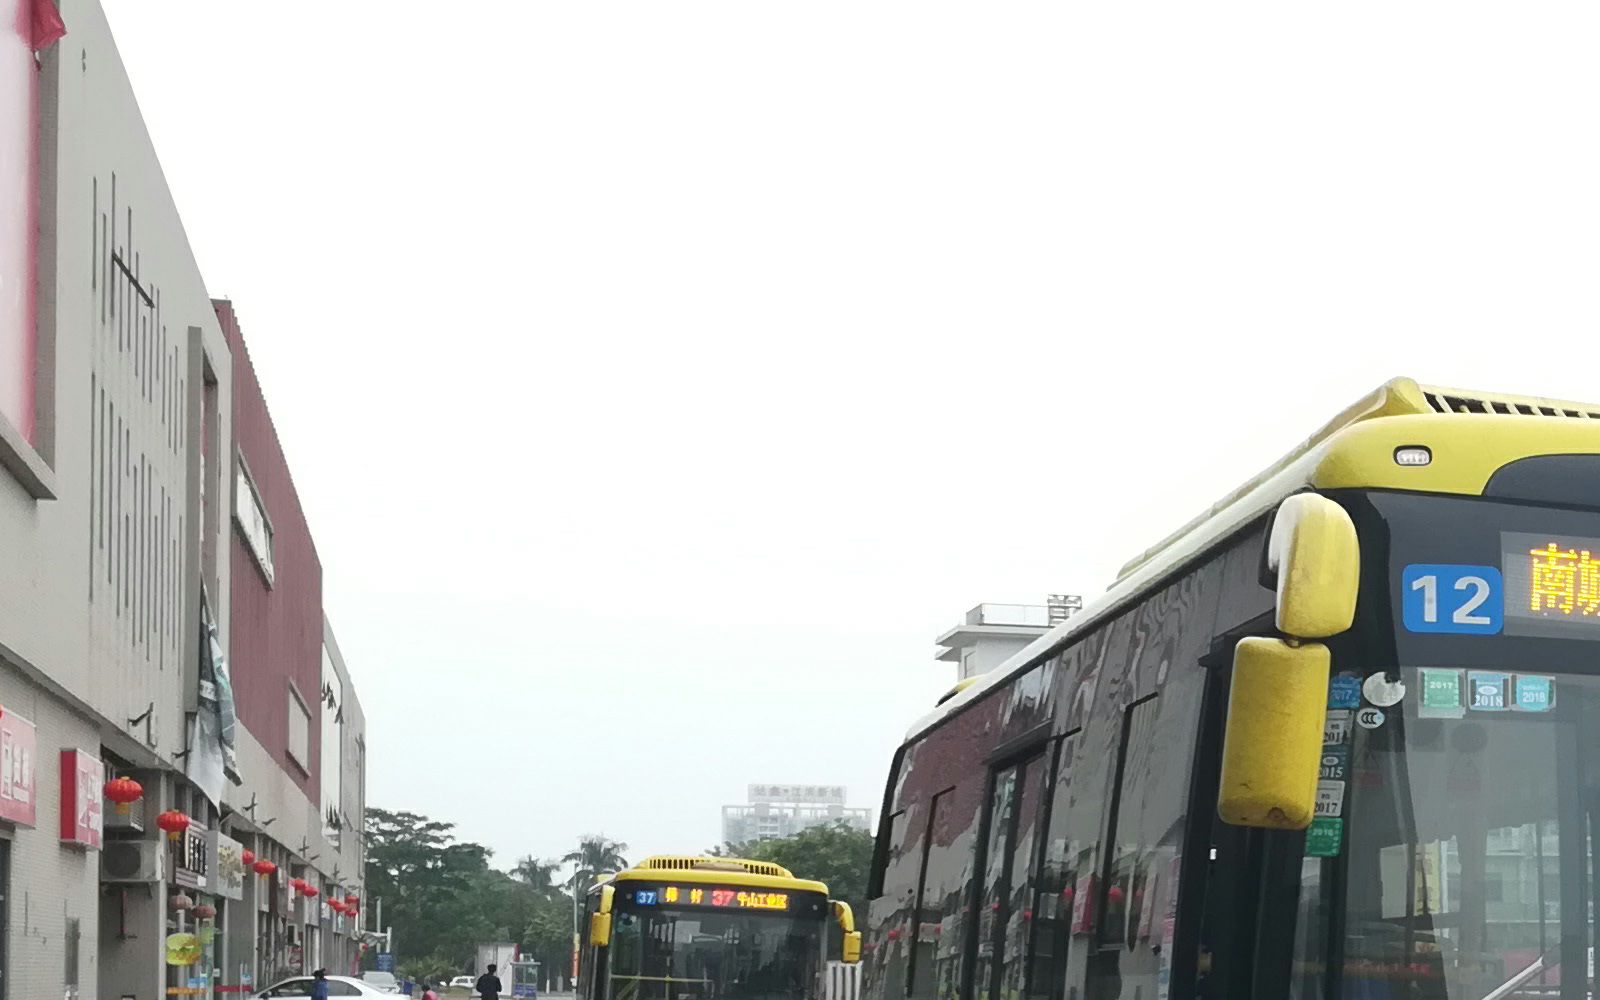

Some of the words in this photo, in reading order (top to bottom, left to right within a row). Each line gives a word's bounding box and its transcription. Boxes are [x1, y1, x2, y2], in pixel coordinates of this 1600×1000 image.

[1412, 575, 1490, 624] 12
[1475, 694, 1503, 707] 2018
[1522, 692, 1546, 703] 2018
[639, 892, 656, 904] 37
[712, 890, 735, 906] 37
